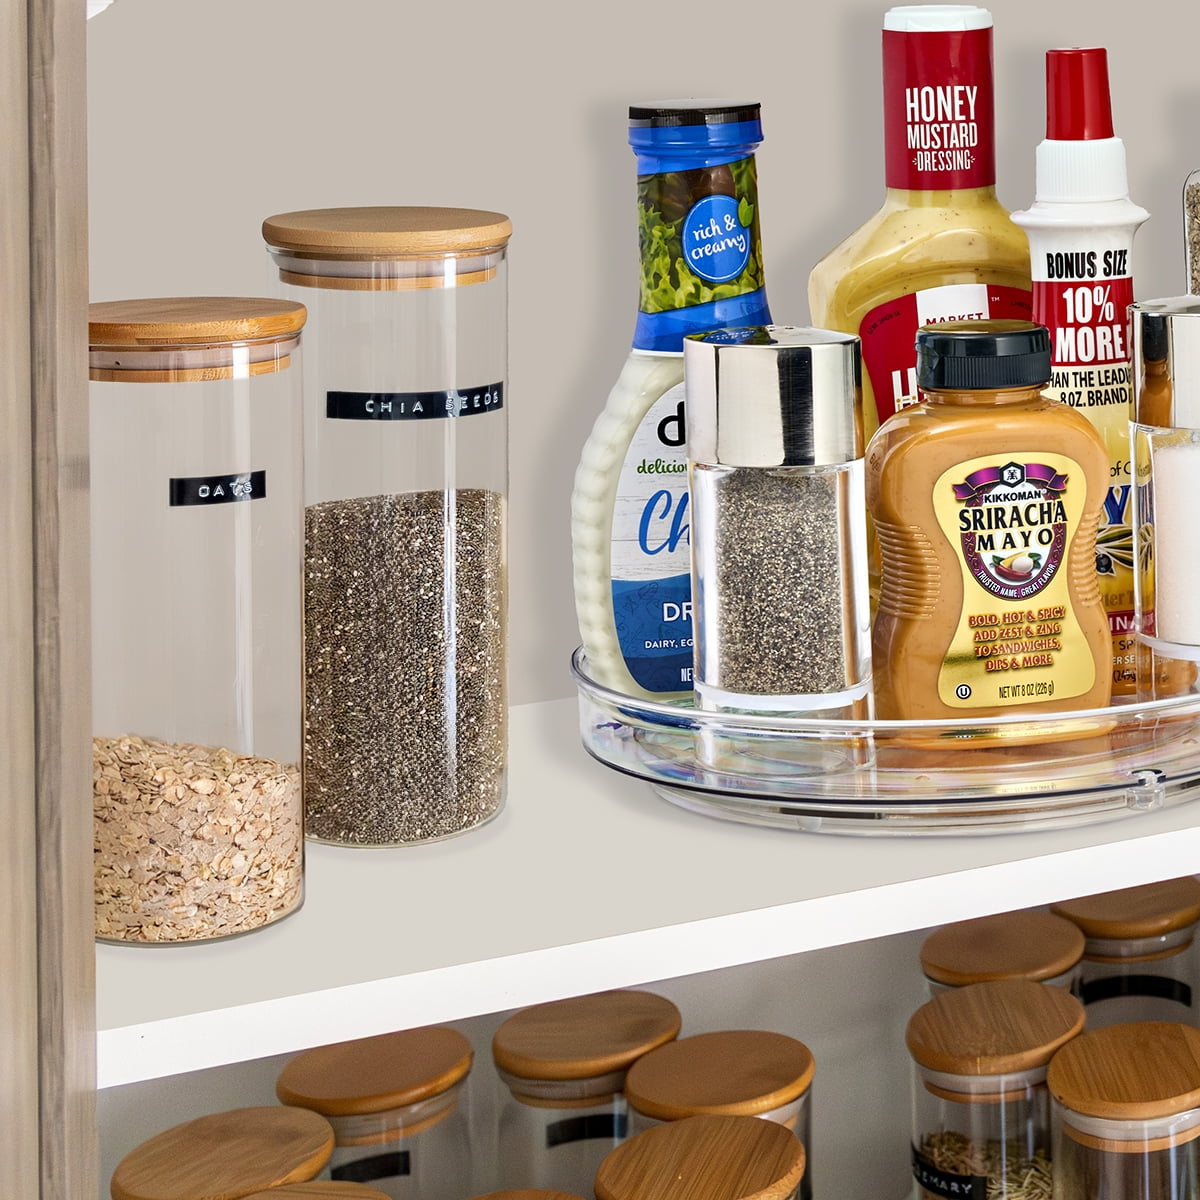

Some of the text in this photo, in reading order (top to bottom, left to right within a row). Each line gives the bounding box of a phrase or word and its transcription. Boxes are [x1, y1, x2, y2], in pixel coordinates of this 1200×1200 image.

[905, 85, 978, 122] HONEY
[906, 122, 978, 150] MUSTARD
[917, 149, 971, 172] DRESSING
[692, 214, 737, 241] rich &
[691, 234, 746, 260] creamy
[1046, 249, 1128, 278] BONUS SIZE
[1062, 284, 1114, 324] 10%
[1055, 324, 1126, 363] MORE
[1072, 371, 1095, 388] THE
[365, 390, 500, 414] CHIA SEEDS
[1060, 387, 1128, 407] 8 OZ. BRAND
[636, 458, 688, 475] delicio
[198, 481, 253, 498] OATS
[984, 490, 1041, 503] KIKKOMAN
[959, 500, 1068, 532] SRIRACHA
[977, 528, 1053, 552] MAYO
[976, 563, 1056, 599] TRUSTED NAME, GREAT FLAVOR
[968, 606, 1066, 628] BOLD, HOT & SPICY
[973, 622, 1061, 642] ADD ZEST & ZING
[645, 638, 694, 649] DAIRY, EG
[975, 638, 1061, 658] TO SANDWICHES,
[985, 653, 1053, 672] DIPS & MORE
[680, 667, 693, 682] NE
[999, 680, 1054, 699] NET WT 8 OZ (226 g)
